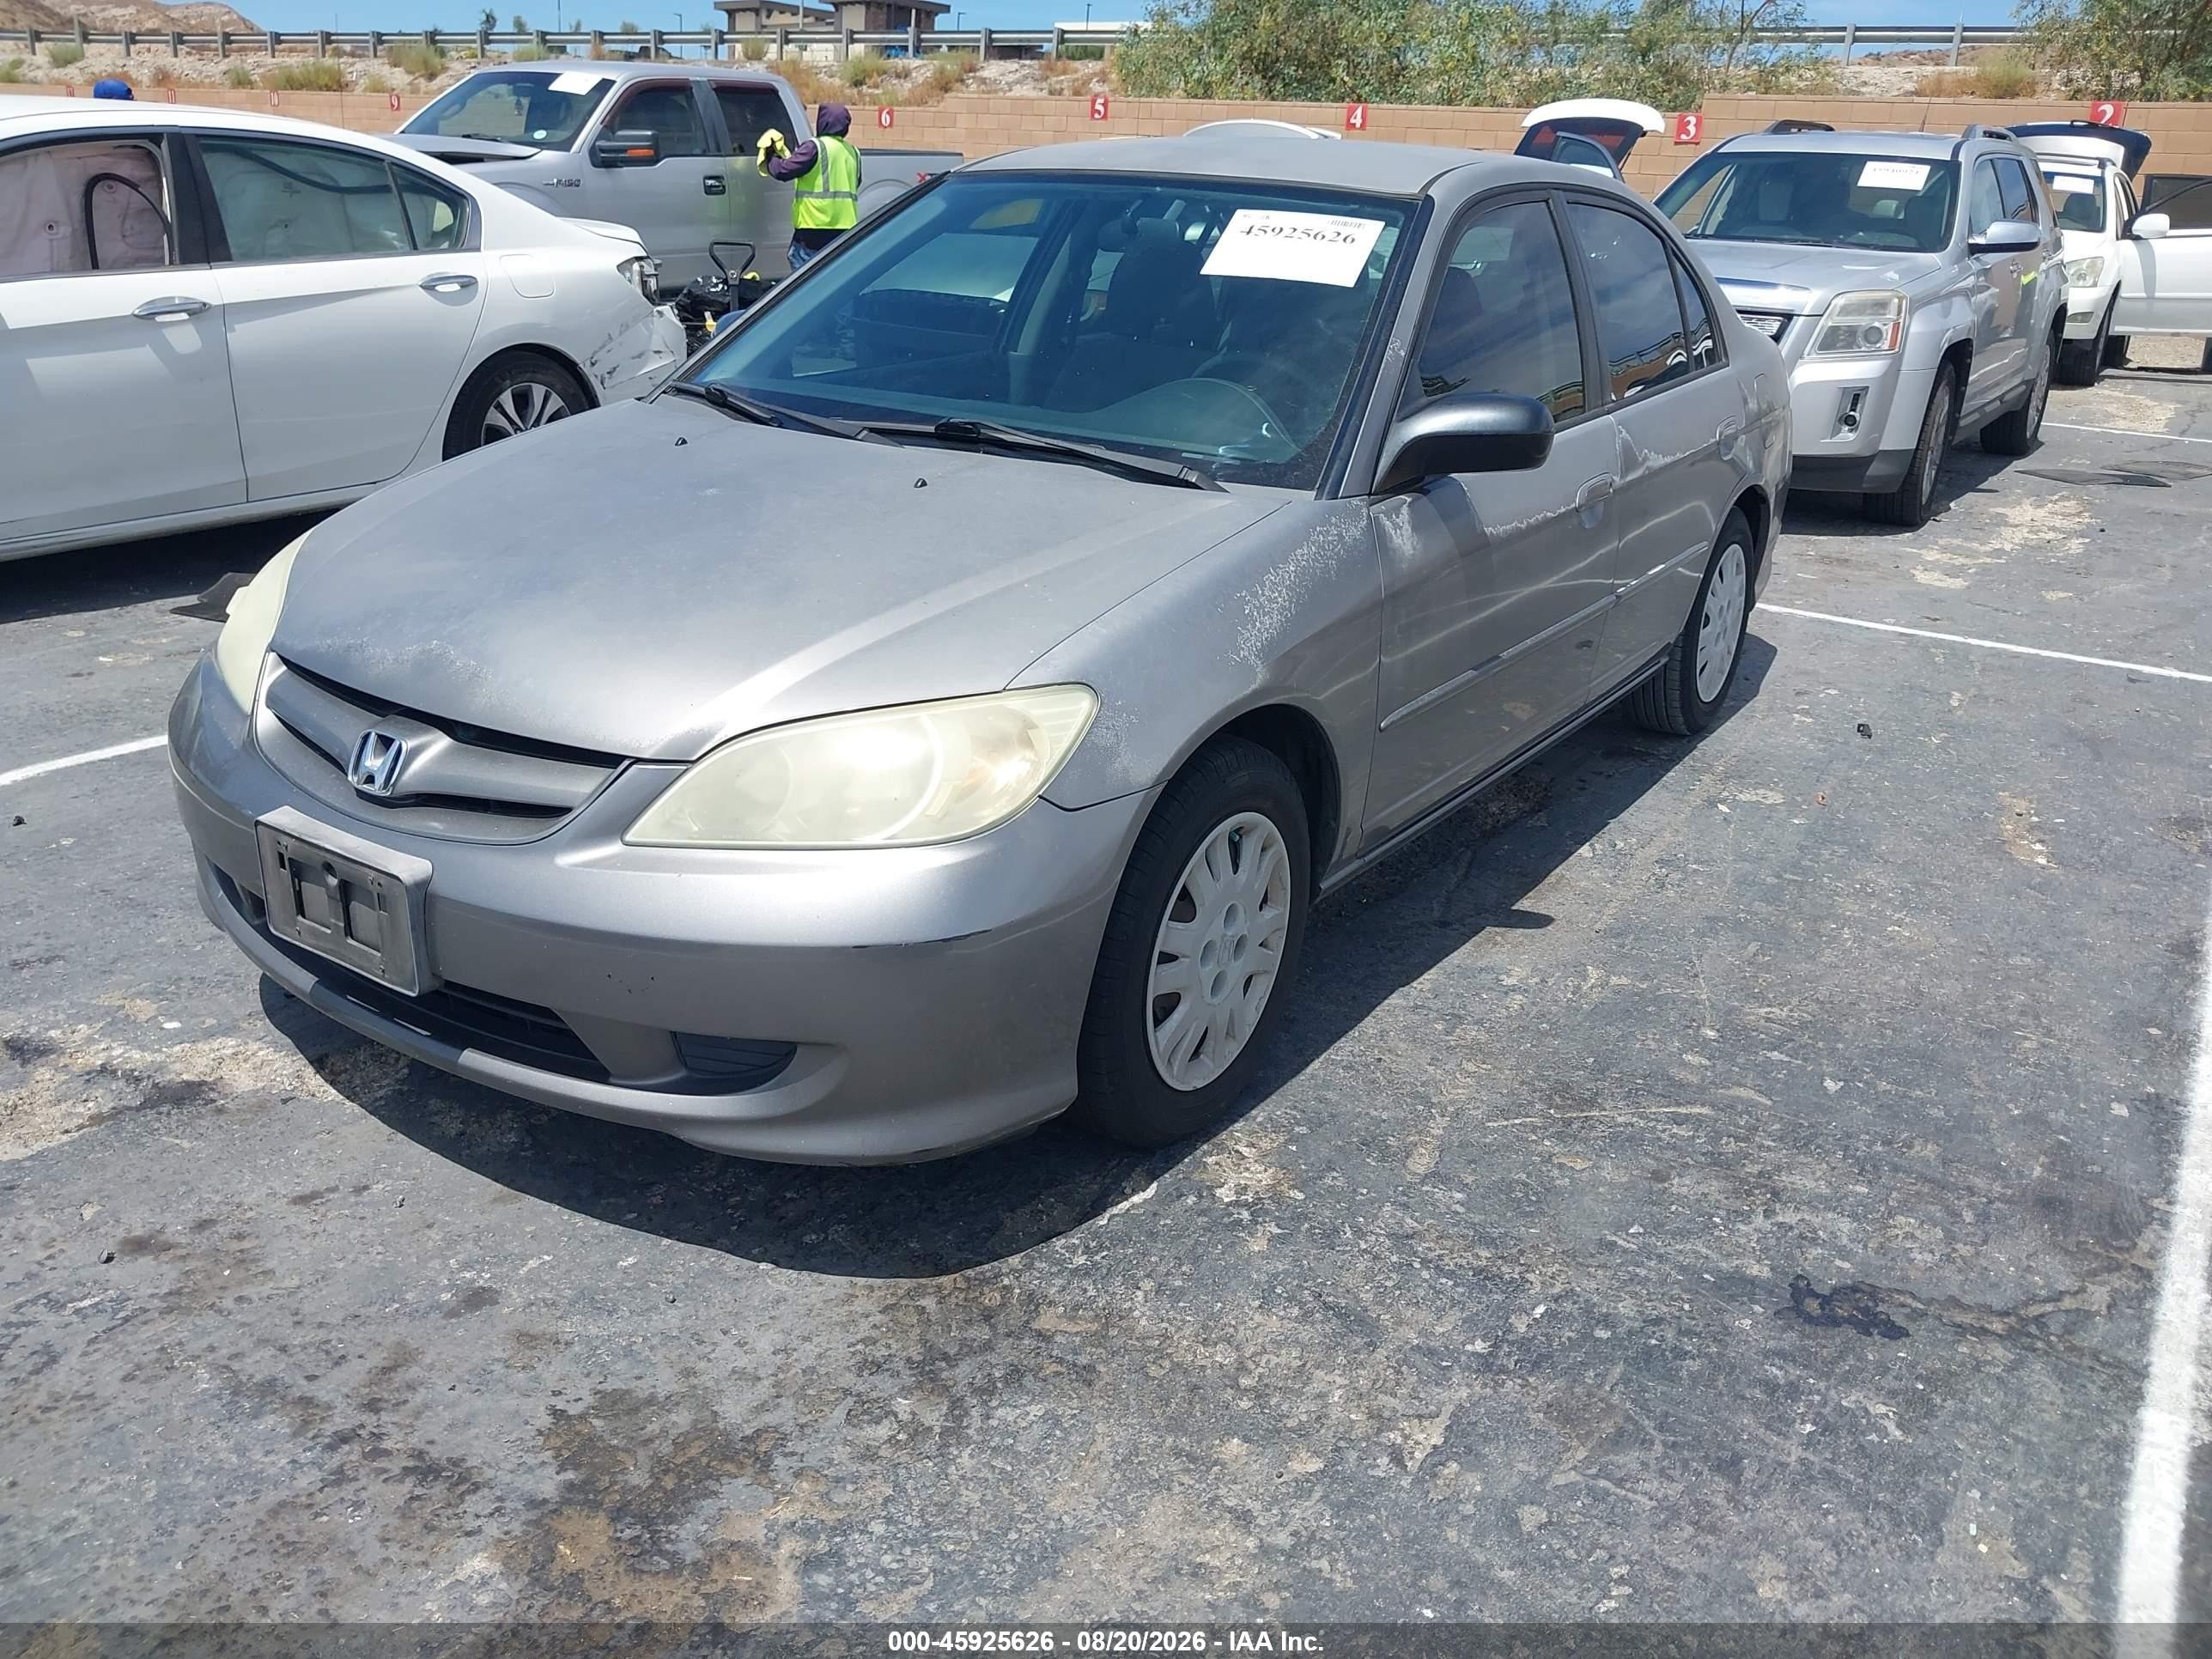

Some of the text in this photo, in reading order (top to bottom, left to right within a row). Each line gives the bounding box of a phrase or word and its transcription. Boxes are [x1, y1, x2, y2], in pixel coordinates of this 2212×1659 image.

[270, 91, 279, 106] 10
[391, 94, 398, 110] 9
[1093, 97, 1105, 118] 5
[880, 108, 891, 127] 6
[1349, 105, 1363, 129] 4
[2097, 103, 2114, 125] 2
[1680, 115, 1697, 140] 3
[1239, 224, 1357, 246] 45925626
